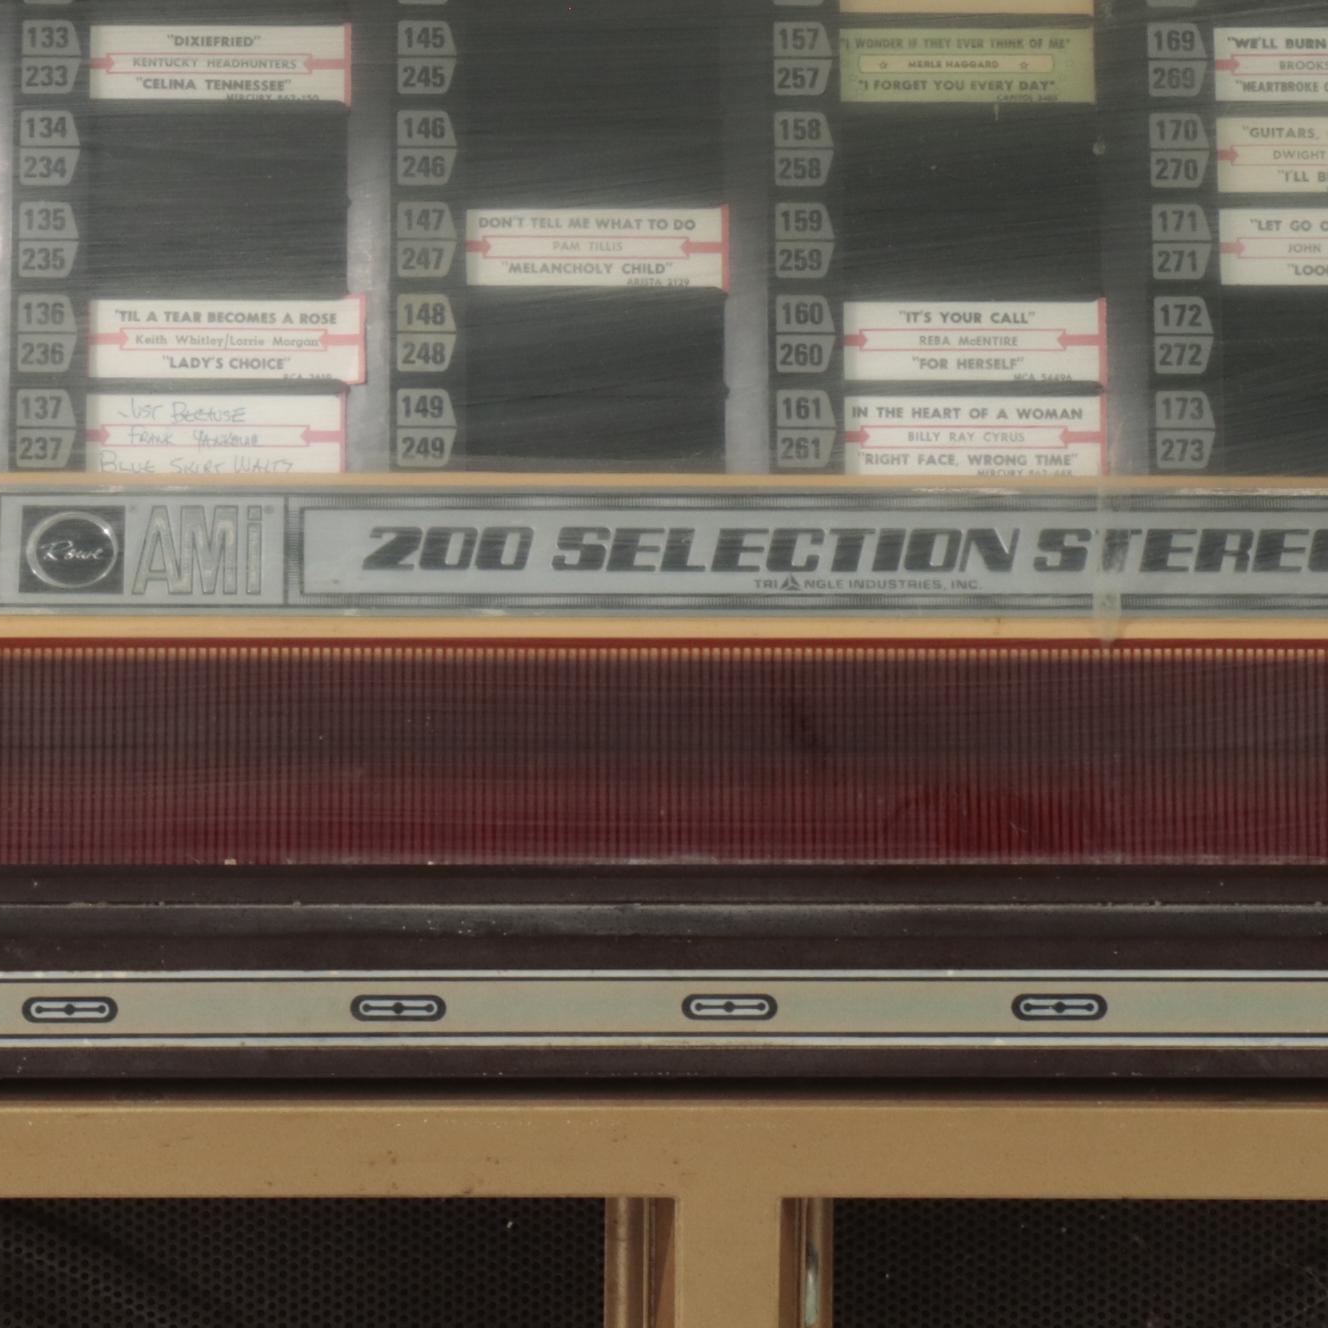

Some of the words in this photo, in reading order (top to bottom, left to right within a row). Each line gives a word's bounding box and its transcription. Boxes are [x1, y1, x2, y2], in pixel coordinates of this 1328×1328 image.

[28, 28, 69, 48] 133
[167, 34, 262, 48] "DIXIEFRIED"
[1153, 30, 1194, 51] 169
[26, 65, 68, 86] 233
[136, 77, 197, 90] "CELINA
[205, 78, 292, 91] TENNESSEE"
[479, 216, 525, 229] DON'T
[531, 218, 563, 230] TELL
[568, 218, 590, 230] ME
[596, 218, 642, 230] WHAT
[649, 219, 668, 231] TO
[673, 220, 696, 231] DO
[1250, 219, 1284, 232] "LET
[1290, 220, 1312, 232] GO
[1288, 243, 1321, 254] JOHN
[402, 249, 442, 269] 247
[501, 261, 613, 274] "MELANCHOLY
[621, 262, 673, 275] CHILD"
[899, 310, 932, 324] "IT'S
[941, 311, 982, 324] YOUR
[990, 311, 1035, 324] CALL"
[135, 334, 168, 345] Keith
[272, 336, 319, 348] Morgan
[919, 336, 949, 346] REBA
[958, 336, 1019, 347] McENTIRE
[22, 343, 63, 364] 236
[780, 344, 823, 365] 260
[162, 356, 224, 370] "LADY'S
[230, 357, 291, 370] CHOICE"
[912, 356, 948, 370] "FOR
[956, 357, 1024, 370] HERSELF"
[401, 436, 444, 459] 249
[361, 526, 535, 572] 200
[550, 526, 1021, 573] SELECTION
[848, 578, 948, 591] INDUSTRIES,
[950, 578, 984, 591] INC.
